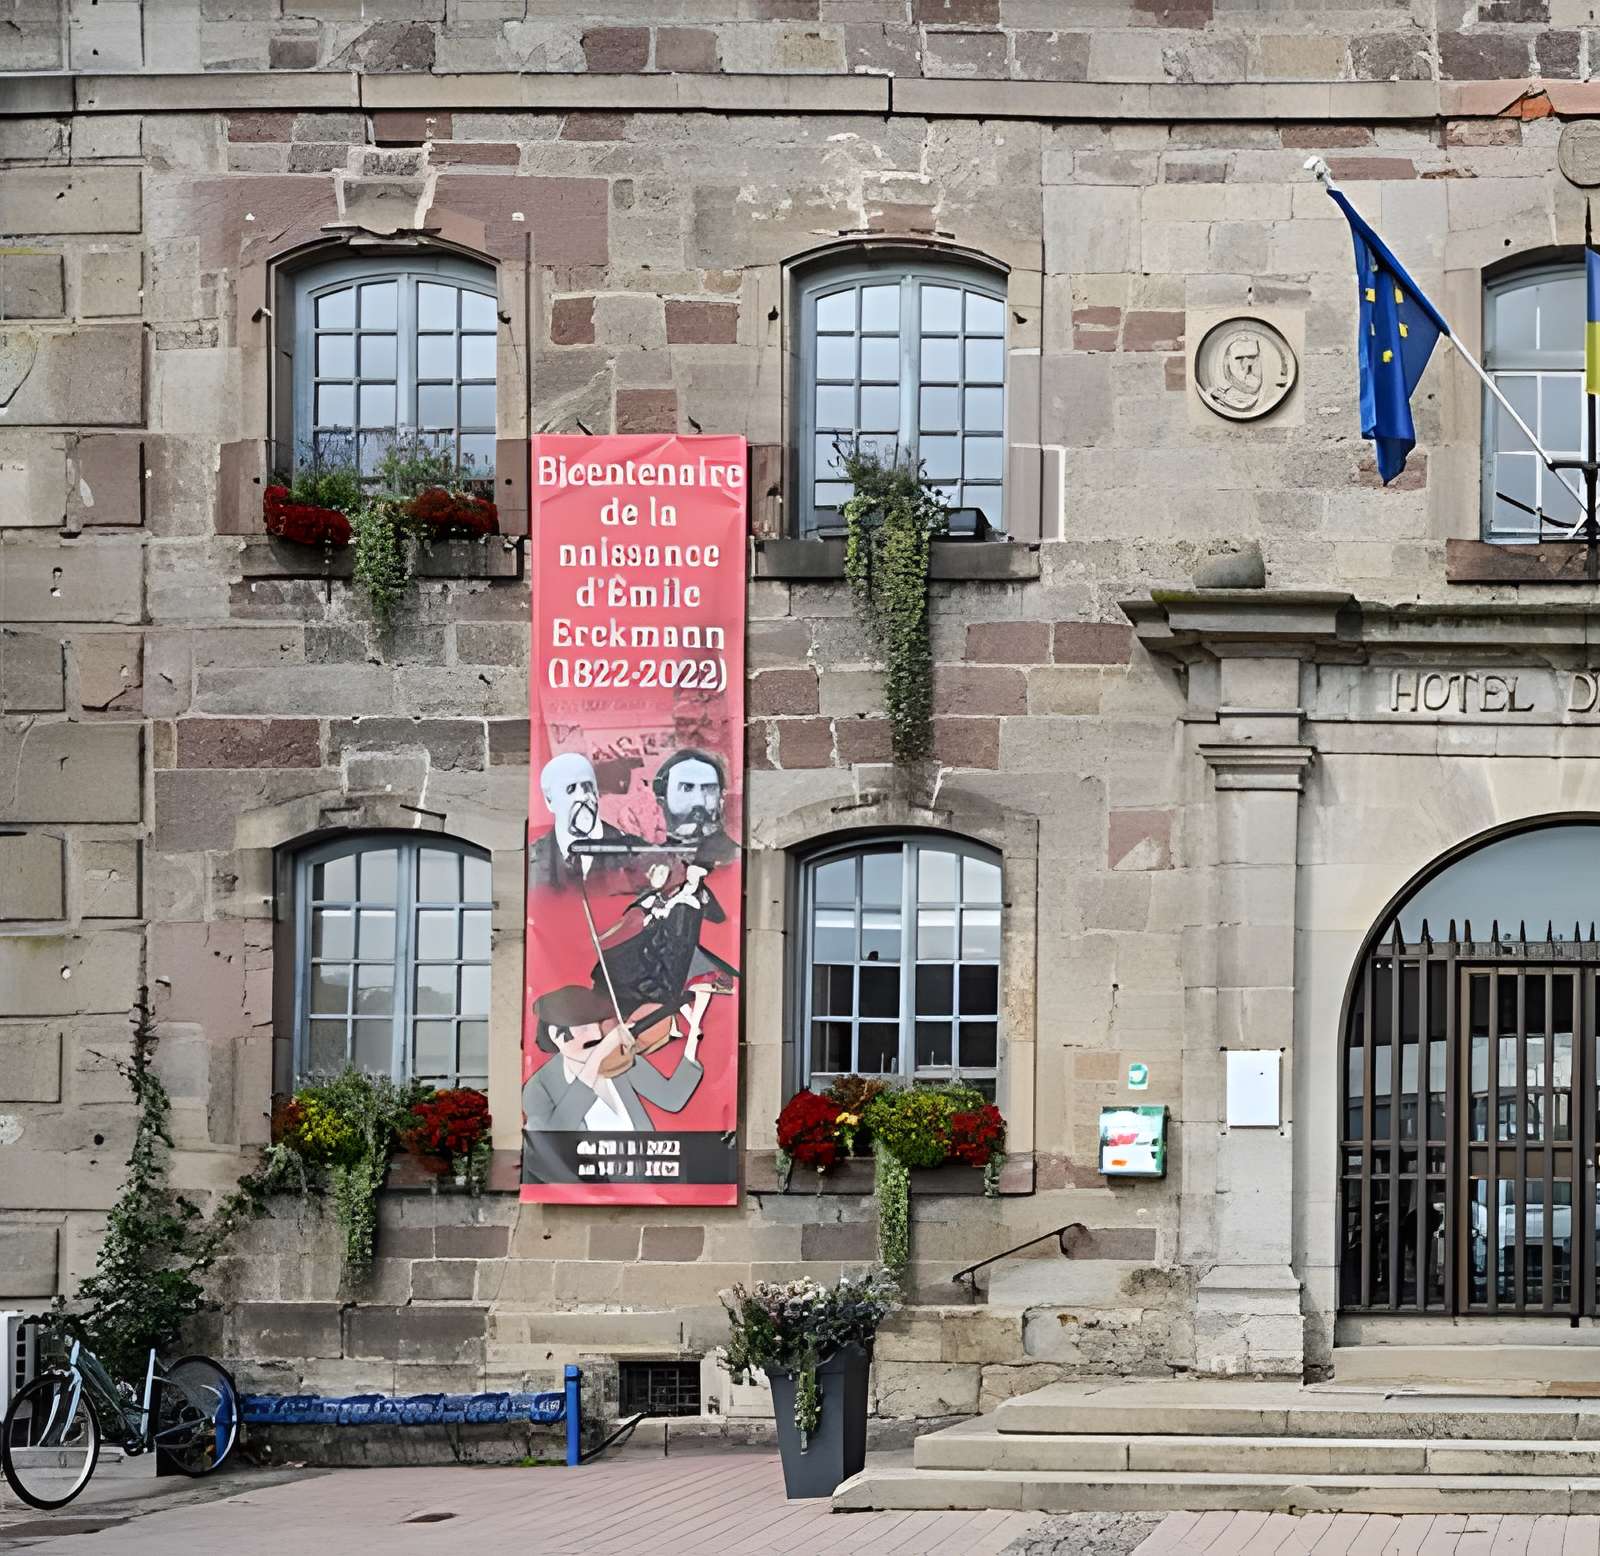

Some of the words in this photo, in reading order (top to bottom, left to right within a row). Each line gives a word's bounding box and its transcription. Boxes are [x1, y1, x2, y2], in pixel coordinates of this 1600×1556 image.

[538, 455, 745, 488] Bicentenaire
[600, 496, 638, 526] de
[649, 496, 677, 526] la
[559, 536, 720, 568] naissance
[552, 617, 725, 650] Erckmann
[1390, 671, 1534, 714] HOTEL
